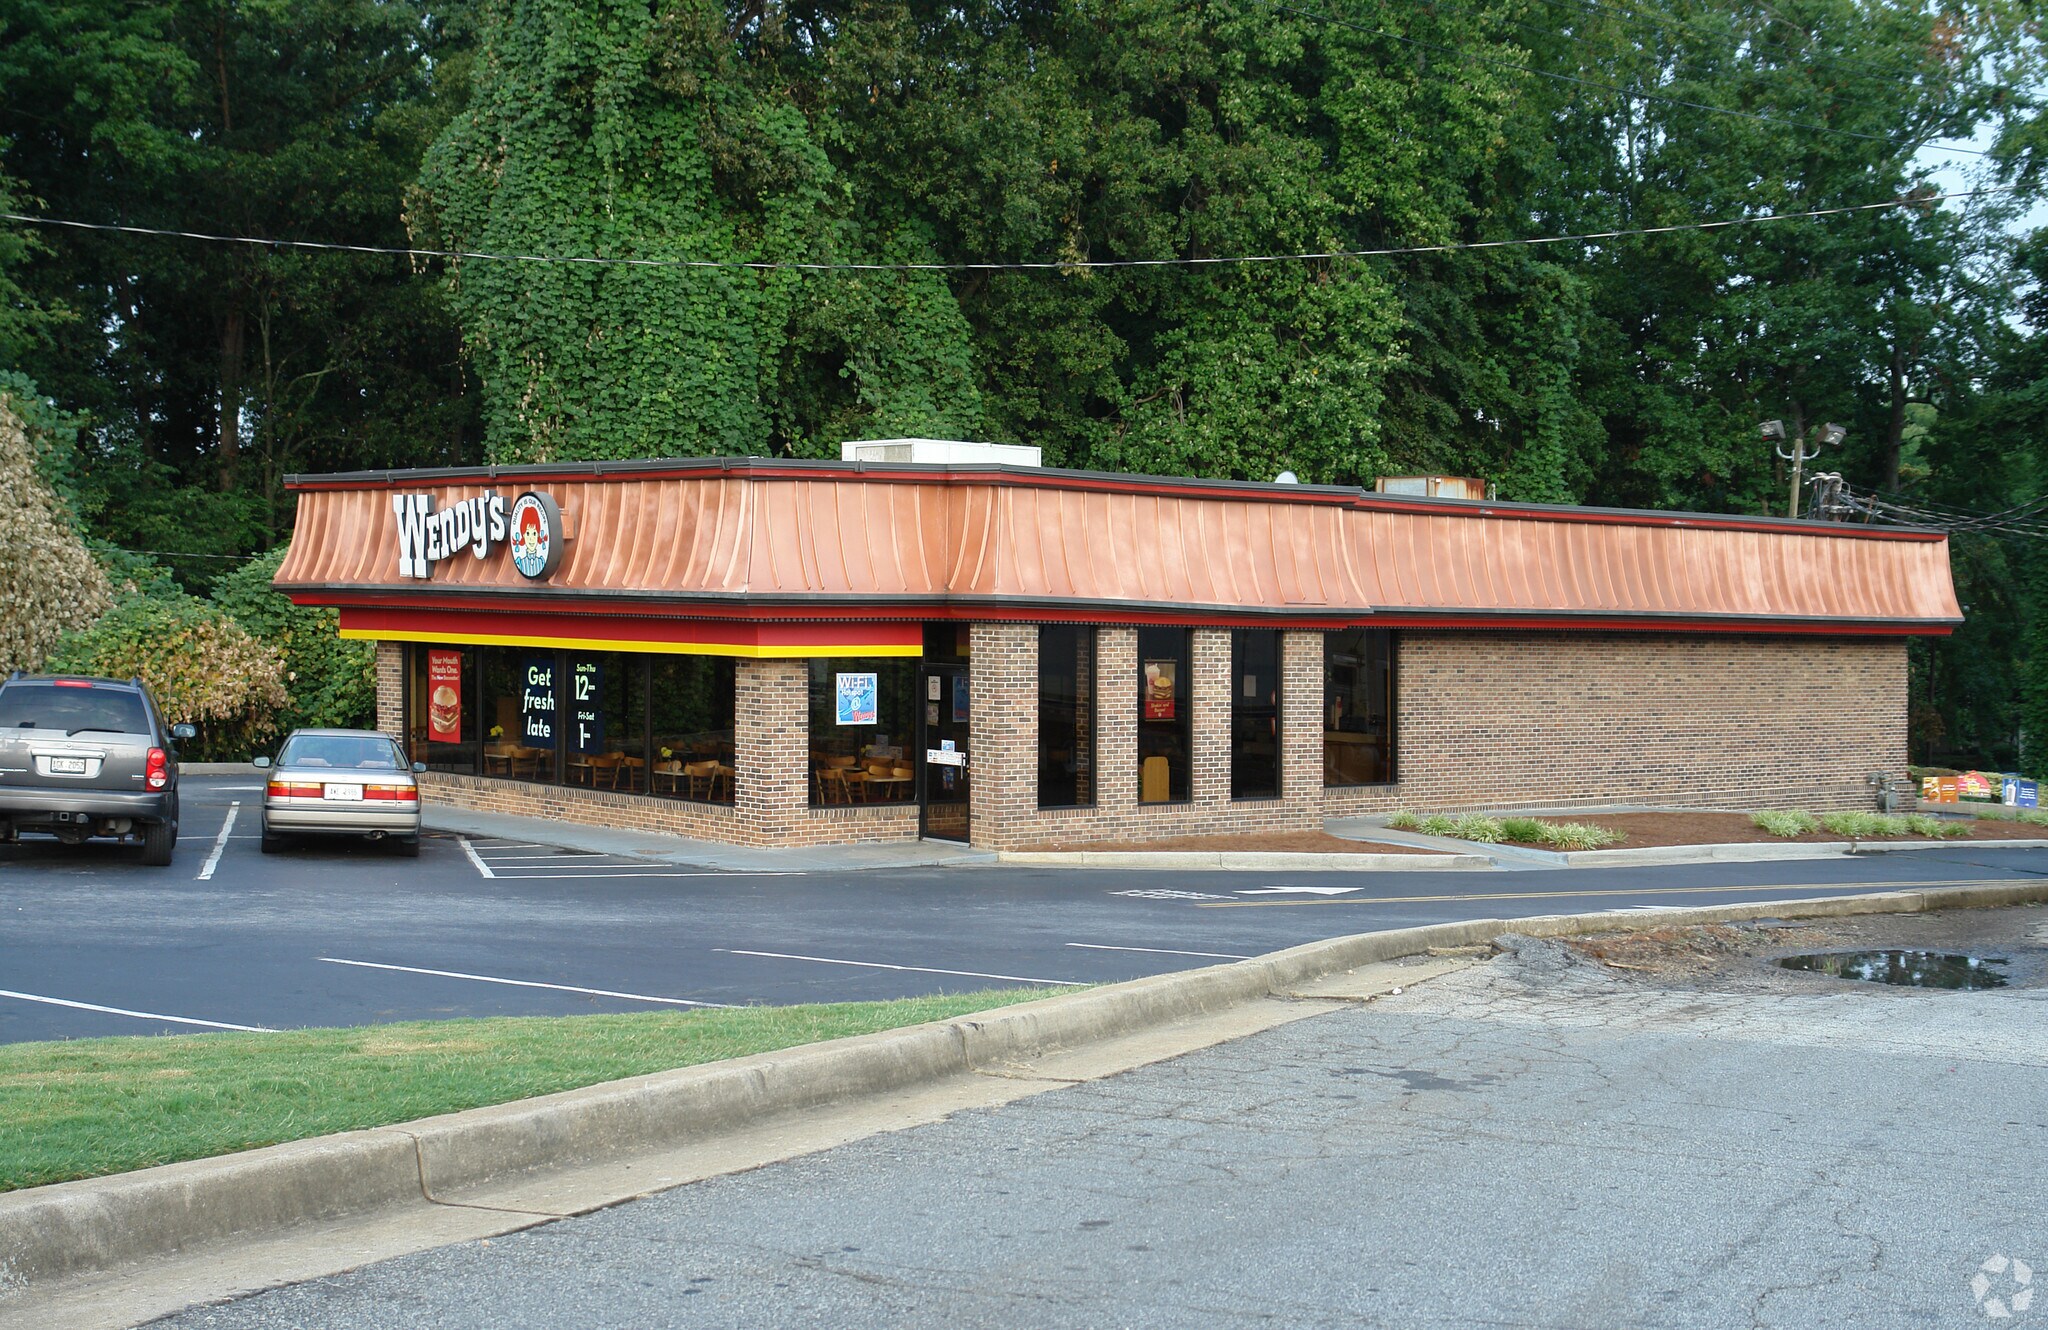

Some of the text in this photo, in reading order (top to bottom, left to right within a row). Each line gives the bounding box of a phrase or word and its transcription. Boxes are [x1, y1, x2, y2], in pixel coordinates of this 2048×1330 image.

[512, 502, 523, 525] QUALITY
[528, 498, 537, 506] OUR
[536, 503, 546, 524] RECIPE
[431, 656, 458, 665] Your Mouth
[576, 663, 596, 673] Sun-Thu
[431, 665, 446, 673] Wants
[528, 666, 551, 686] Get
[522, 688, 555, 713] fresh
[577, 711, 595, 721] Fri-Sat
[527, 715, 551, 738] late
